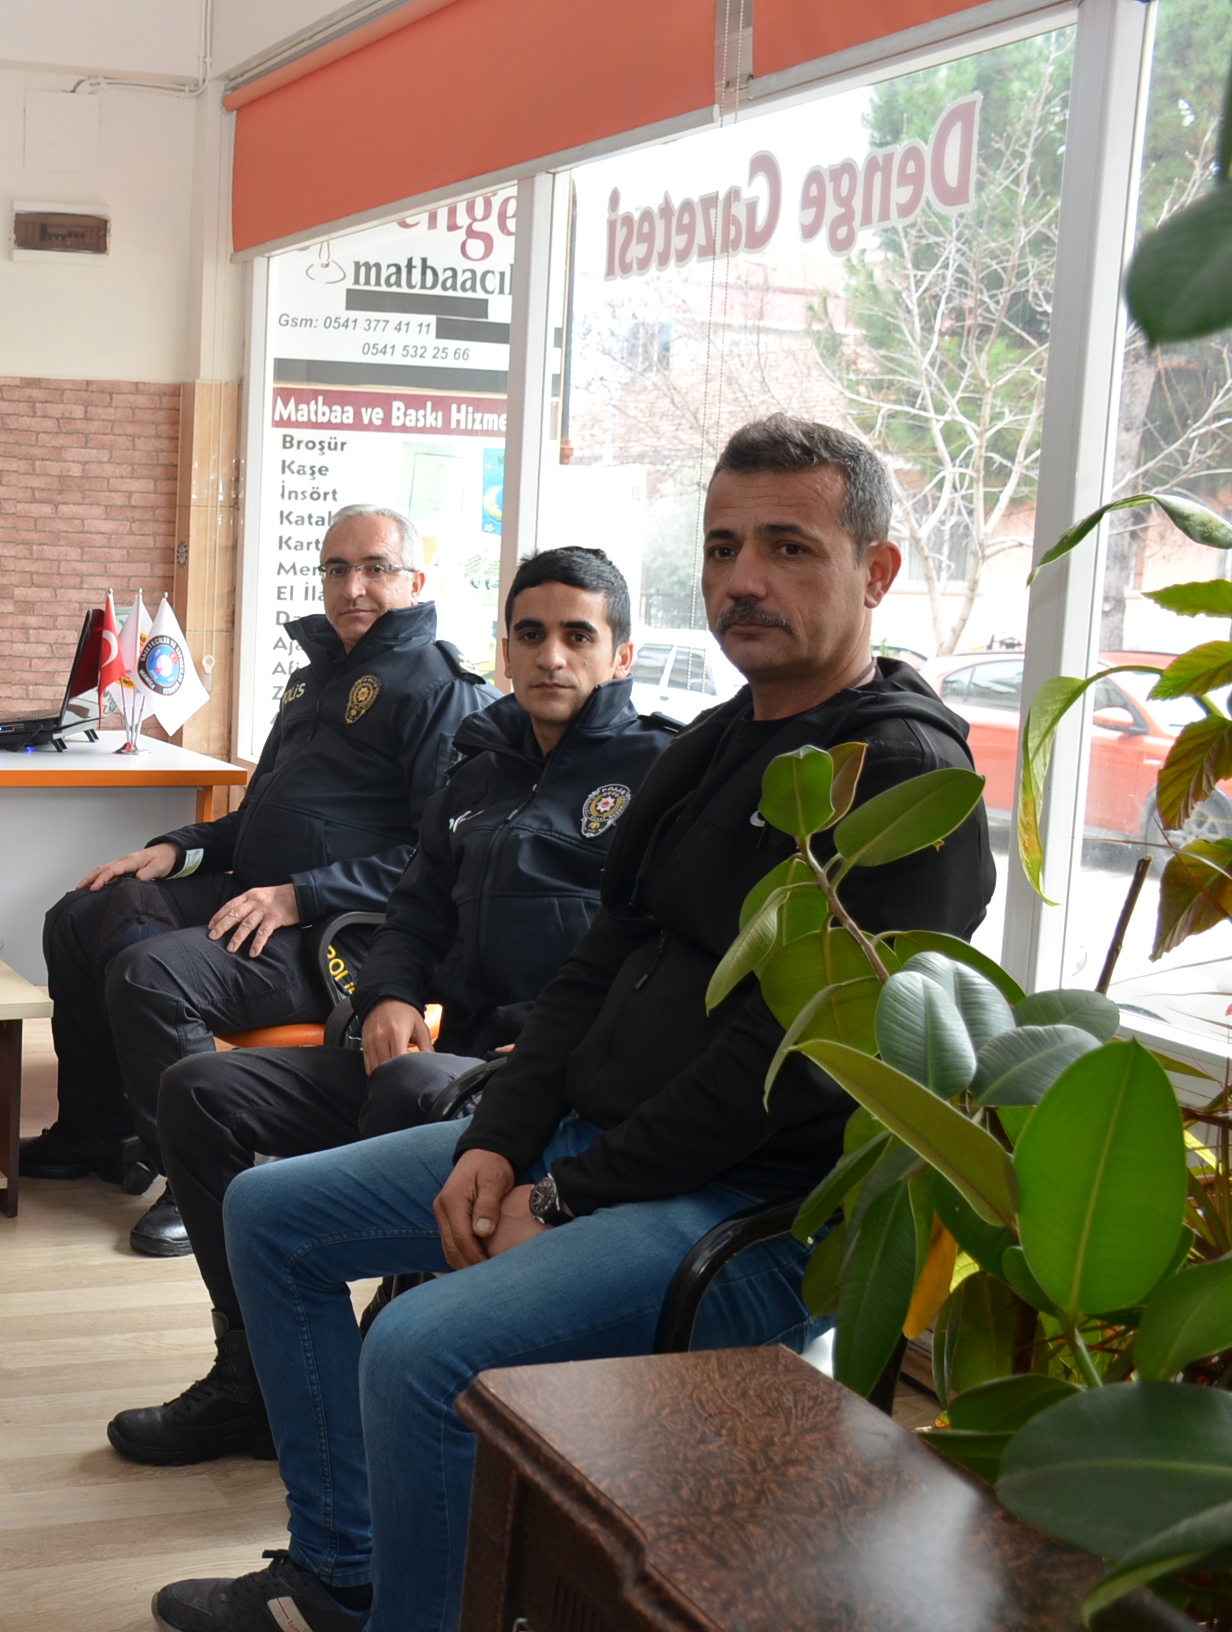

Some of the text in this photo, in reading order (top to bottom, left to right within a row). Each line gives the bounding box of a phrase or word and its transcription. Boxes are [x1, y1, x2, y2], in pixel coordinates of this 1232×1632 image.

[278, 313, 431, 335] Gsm: 0541 377 41 11
[362, 342, 470, 361] 0541 532 25 66
[274, 395, 354, 425] Matbaa
[361, 406, 384, 426] ve
[392, 401, 443, 429] Baskı
[281, 434, 347, 455] Broşür
[281, 459, 329, 480] Kaşe
[280, 481, 338, 502] İnsört
[279, 510, 332, 527] Katal
[278, 535, 323, 551] Kart
[277, 581, 325, 602] El İla
